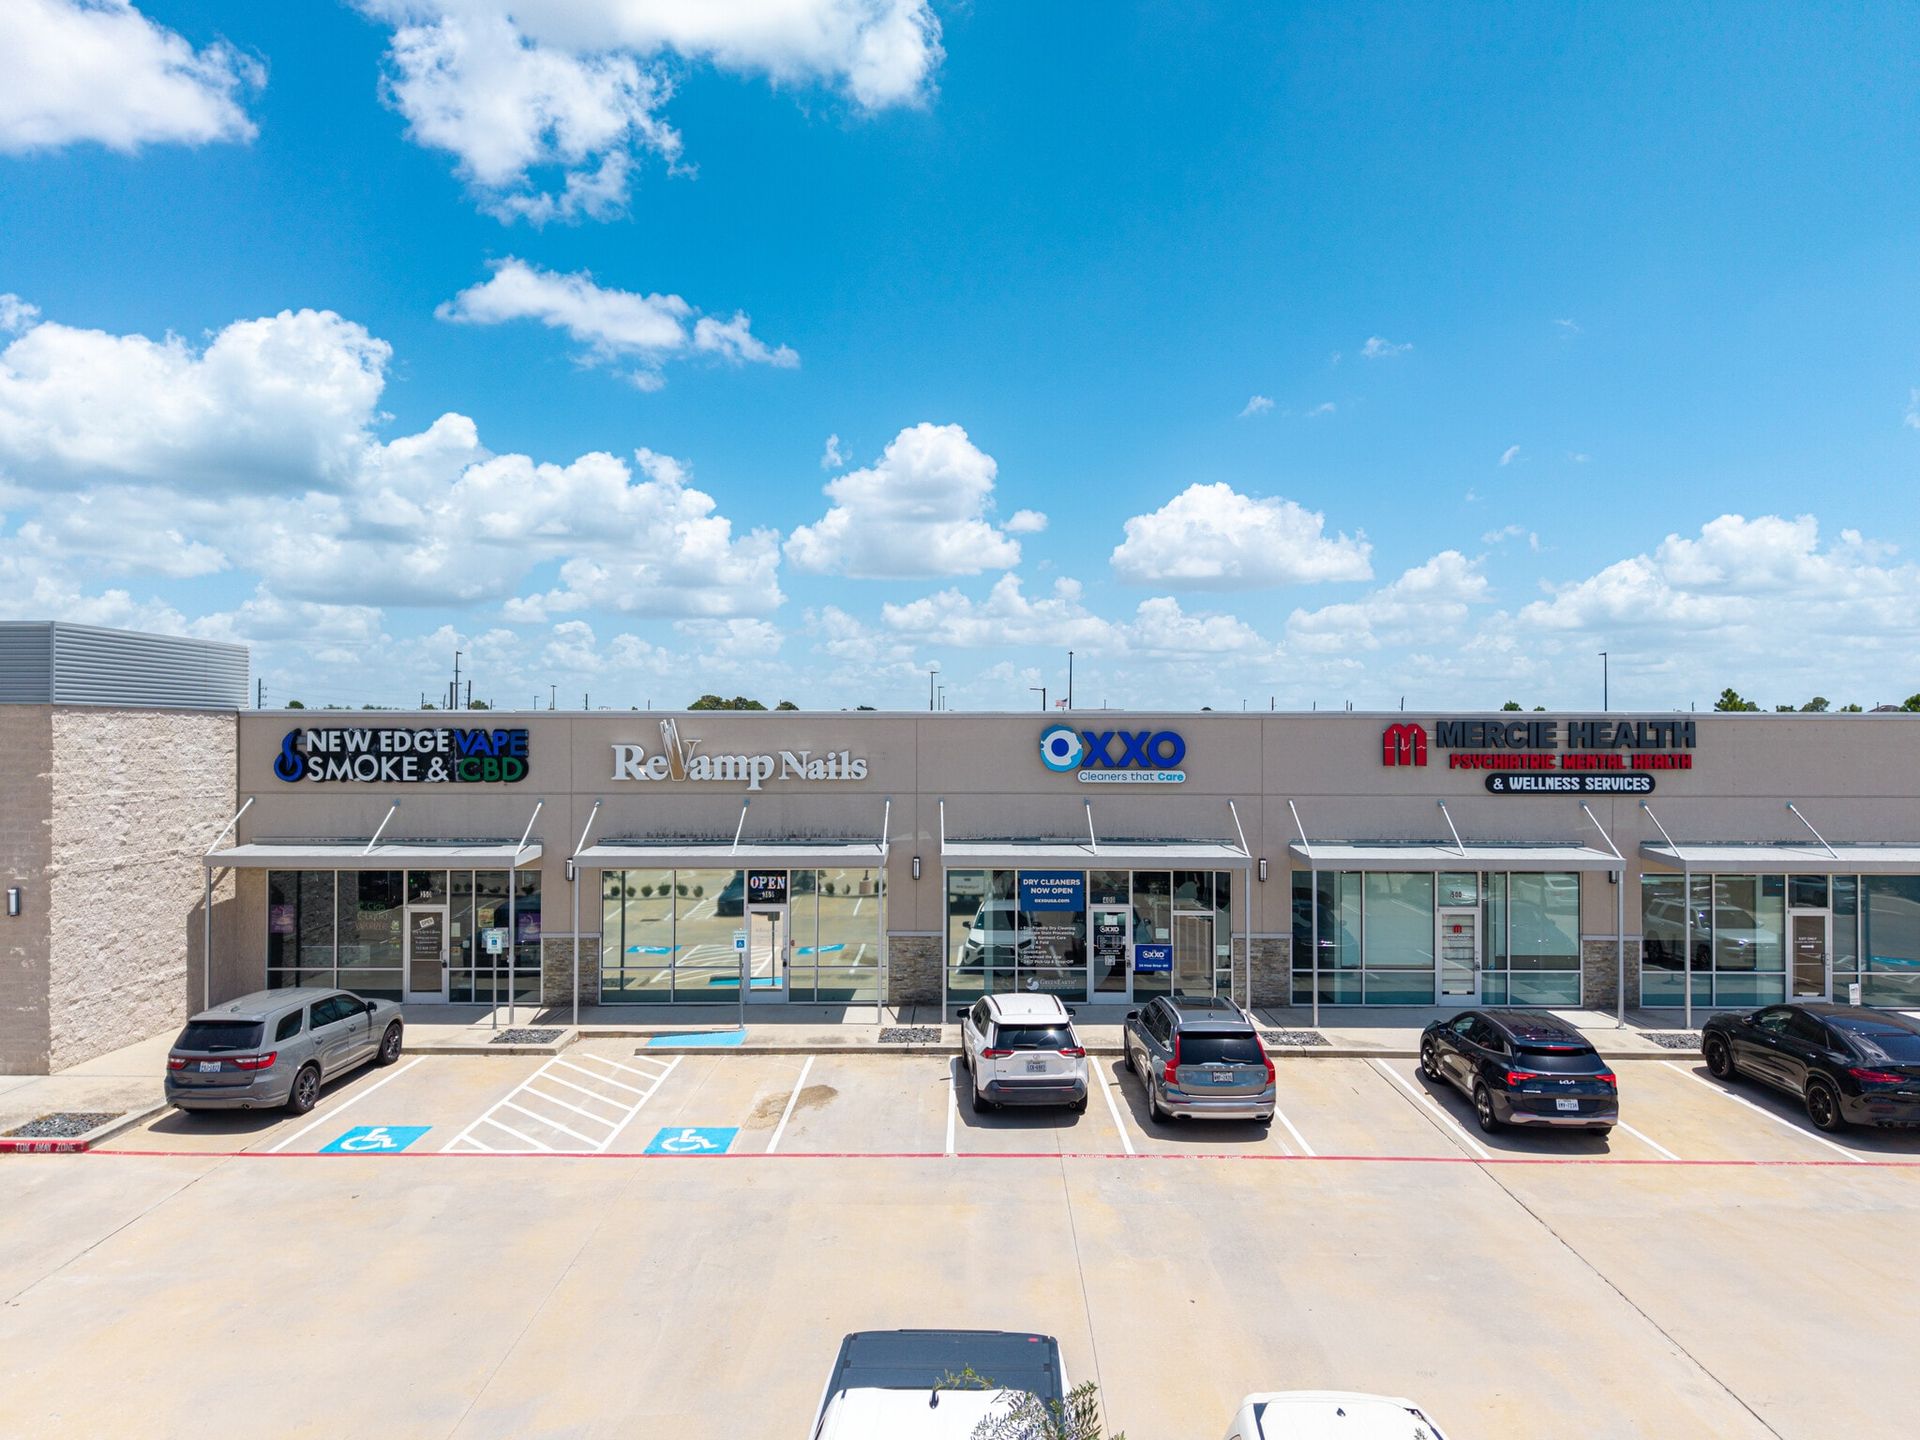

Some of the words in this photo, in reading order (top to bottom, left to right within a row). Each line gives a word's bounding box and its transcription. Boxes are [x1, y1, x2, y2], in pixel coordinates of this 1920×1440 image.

[1436, 721, 1558, 748] MERCIE
[1567, 721, 1696, 748] HEALTH
[306, 731, 373, 752] NEW
[379, 731, 450, 752] EDGE
[454, 729, 530, 756] VAPE
[307, 754, 418, 782] SMOKE
[427, 756, 449, 782] &
[458, 757, 525, 782] CBD
[778, 750, 868, 780] Nails
[1450, 754, 1555, 769] PSYCHIATRIC
[1561, 754, 1626, 769] MENTAL
[1631, 754, 1692, 769] HEALTH
[1079, 771, 1128, 782] Cleaners
[1130, 771, 1154, 782] that
[1157, 772, 1184, 782] Care
[1493, 778, 1504, 790] &
[1509, 777, 1580, 791] WELLNESS
[1584, 777, 1650, 791] SERVICES
[750, 876, 786, 889] OPEN
[55, 1143, 76, 1152] ZONE
